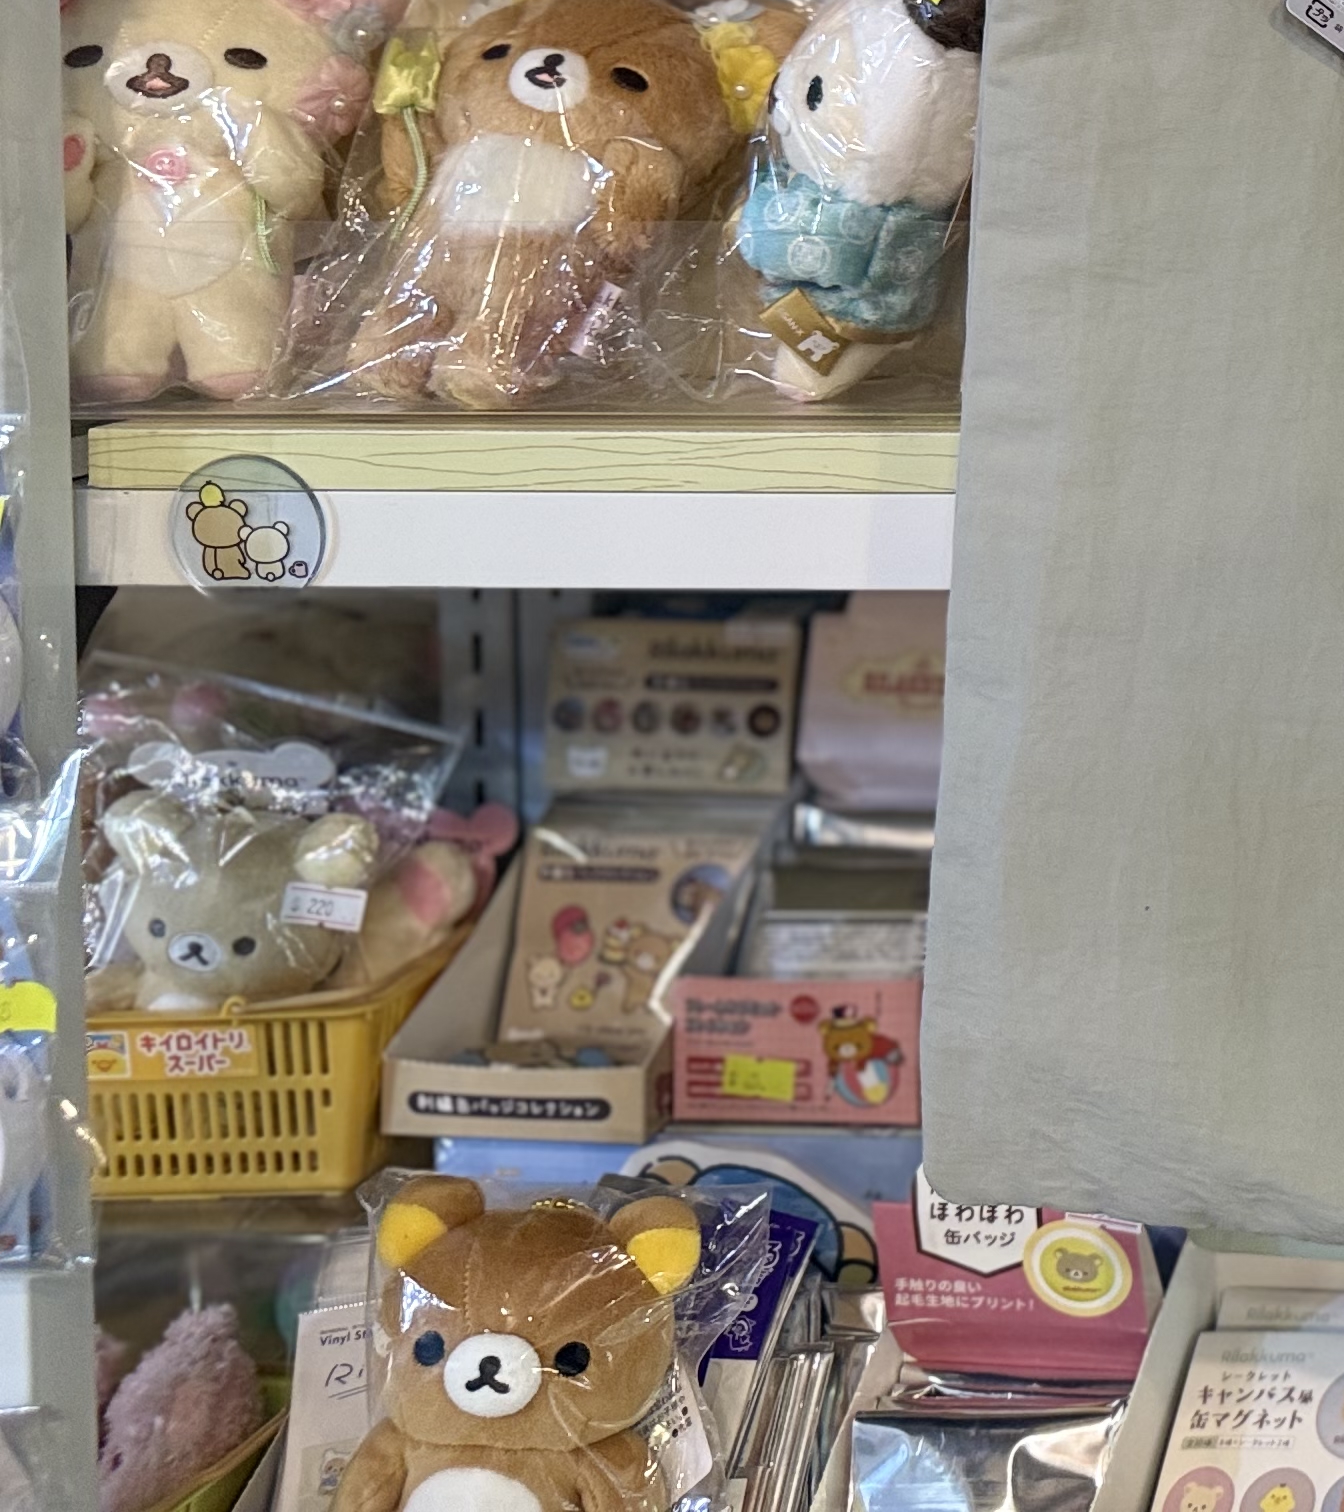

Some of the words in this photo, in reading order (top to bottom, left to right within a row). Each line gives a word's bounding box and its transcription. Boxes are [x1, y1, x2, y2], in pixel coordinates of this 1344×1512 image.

[306, 898, 334, 917] 220
[140, 1031, 245, 1052] キイロイトリ
[167, 1054, 227, 1073] スーパー
[929, 1202, 1025, 1225] ほわほわ
[944, 1229, 1016, 1247] 缶バッジ
[895, 1277, 982, 1293] 手触りの良い
[320, 1331, 351, 1346] Vinyl
[1197, 1384, 1314, 1405] キャンバス風
[1189, 1409, 1303, 1430] 缶マグネット
